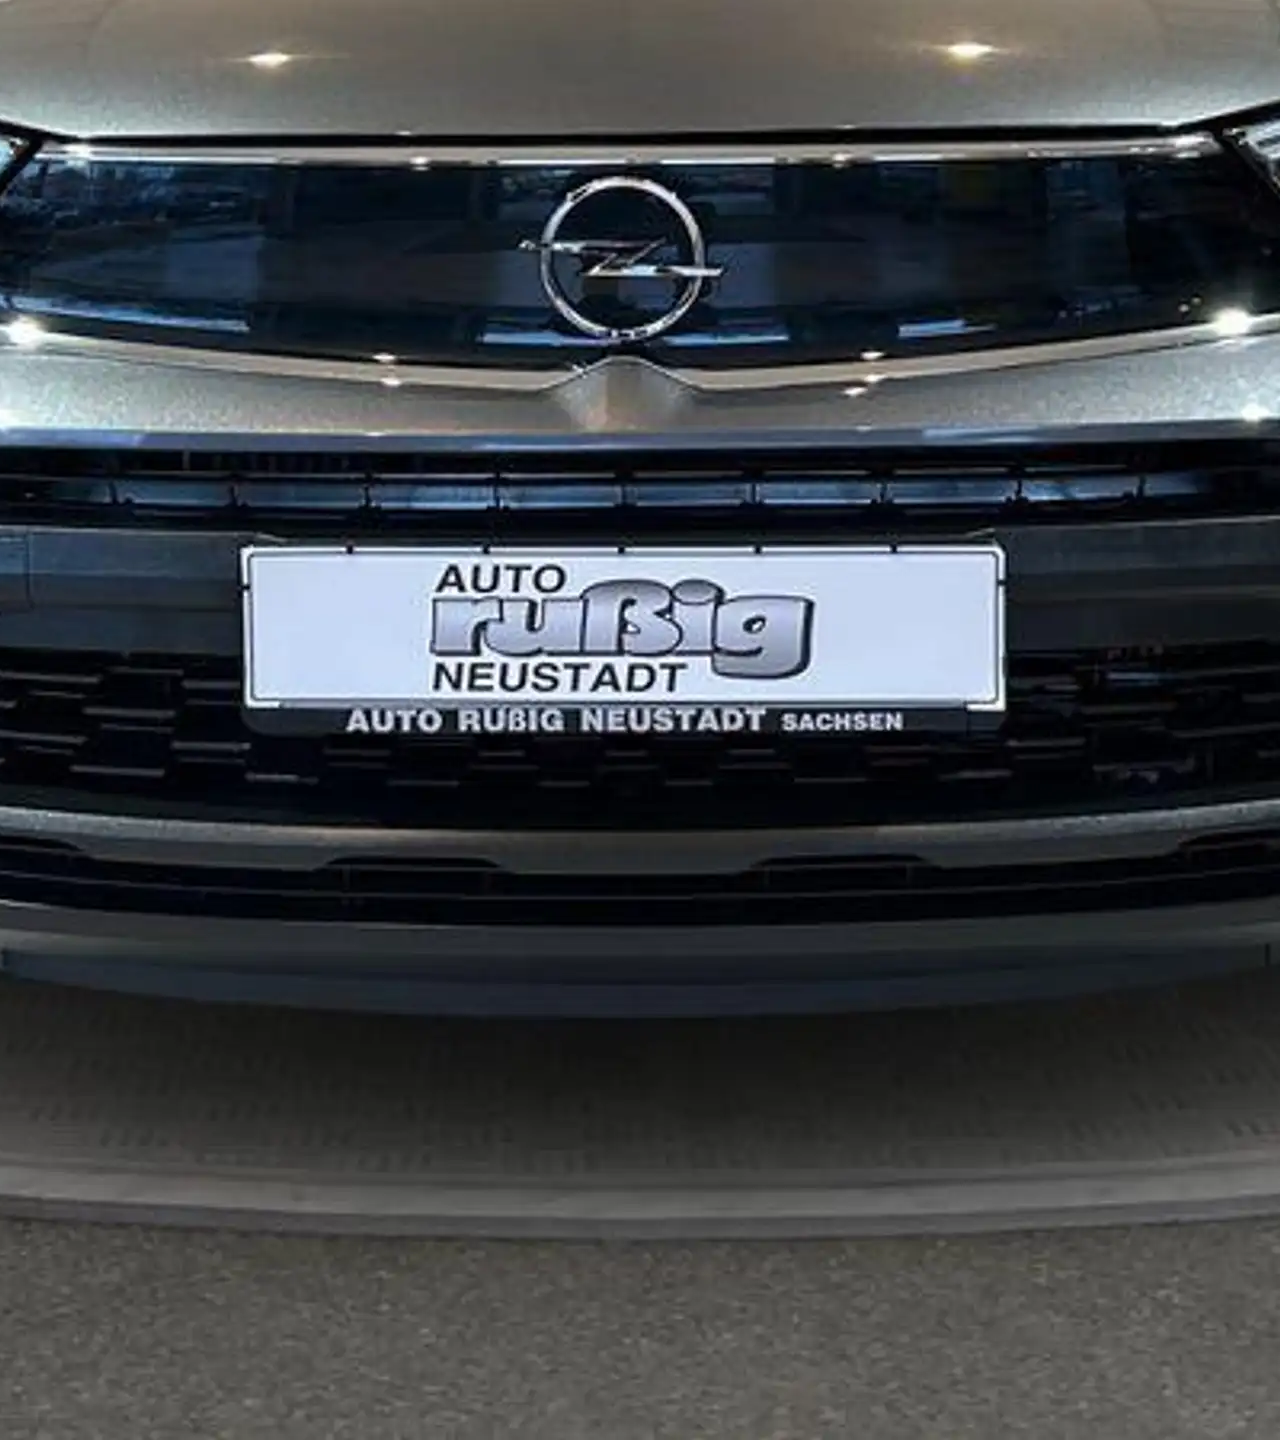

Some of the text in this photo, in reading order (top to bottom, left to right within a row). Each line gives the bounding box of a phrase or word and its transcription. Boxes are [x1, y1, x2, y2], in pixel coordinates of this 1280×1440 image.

[435, 563, 567, 594] AUTO
[431, 662, 686, 694] NEUSTADT
[346, 709, 443, 733] AUTO
[580, 707, 767, 733] NEUSTADT
[782, 714, 904, 732] SACHSEN
